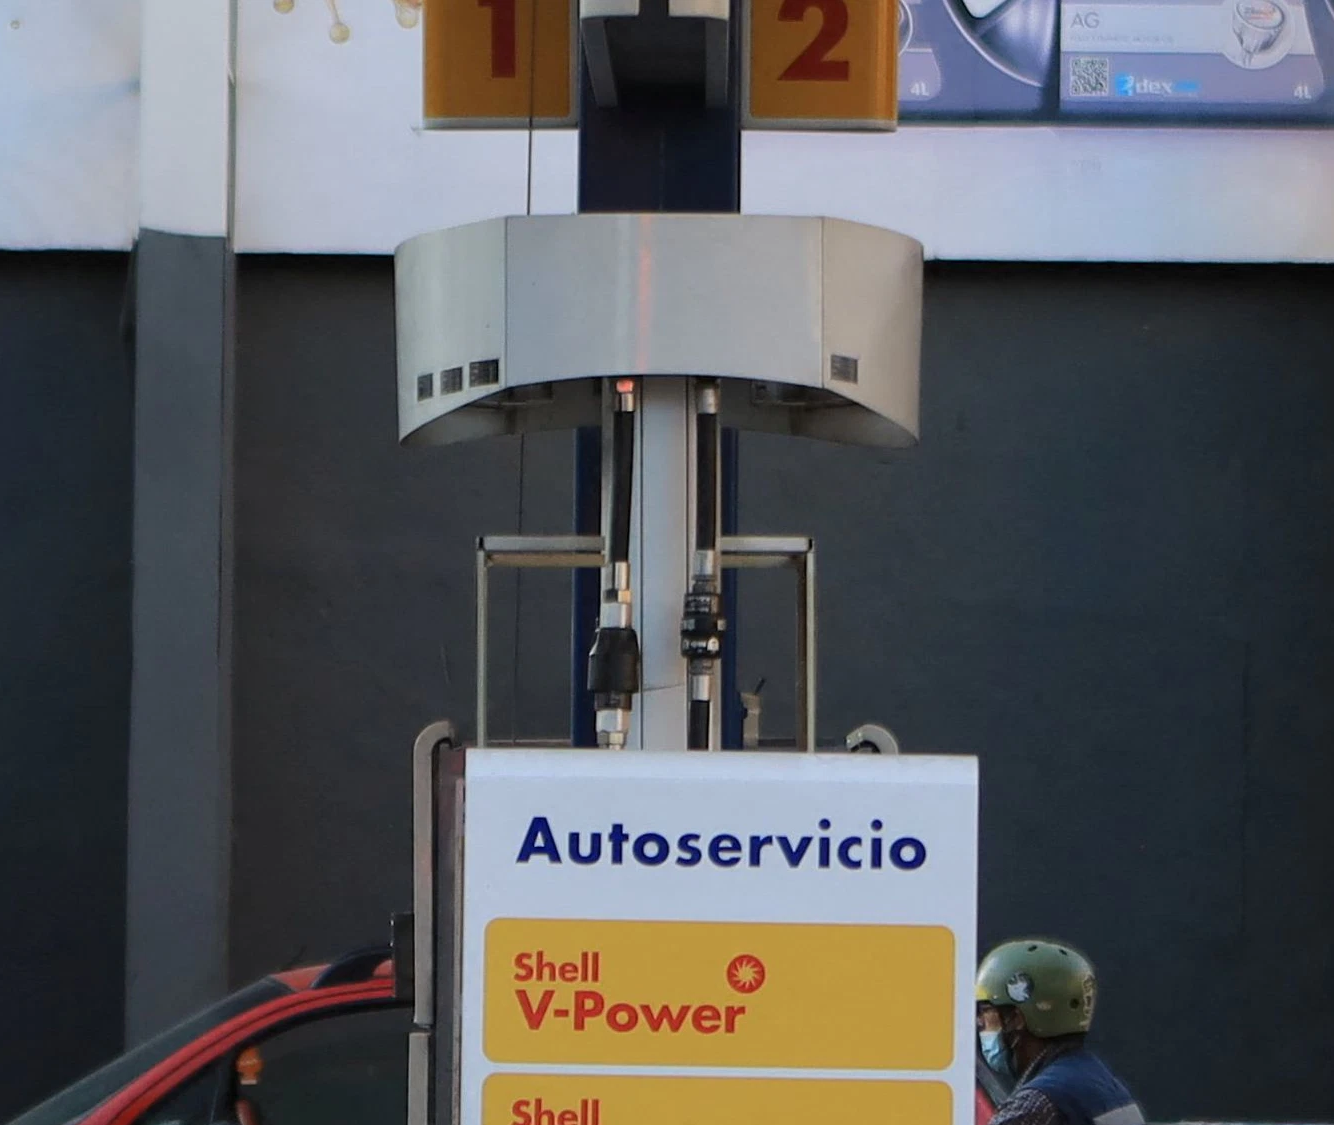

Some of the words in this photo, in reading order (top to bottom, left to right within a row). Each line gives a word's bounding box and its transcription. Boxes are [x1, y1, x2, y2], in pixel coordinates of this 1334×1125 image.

[476, 0, 516, 79] 1
[776, 0, 850, 82] 2
[1070, 11, 1100, 29] AG
[909, 82, 930, 96] 4L
[515, 815, 928, 871] Autoservicio
[513, 950, 600, 983] Shell
[513, 989, 747, 1035] V-Power
